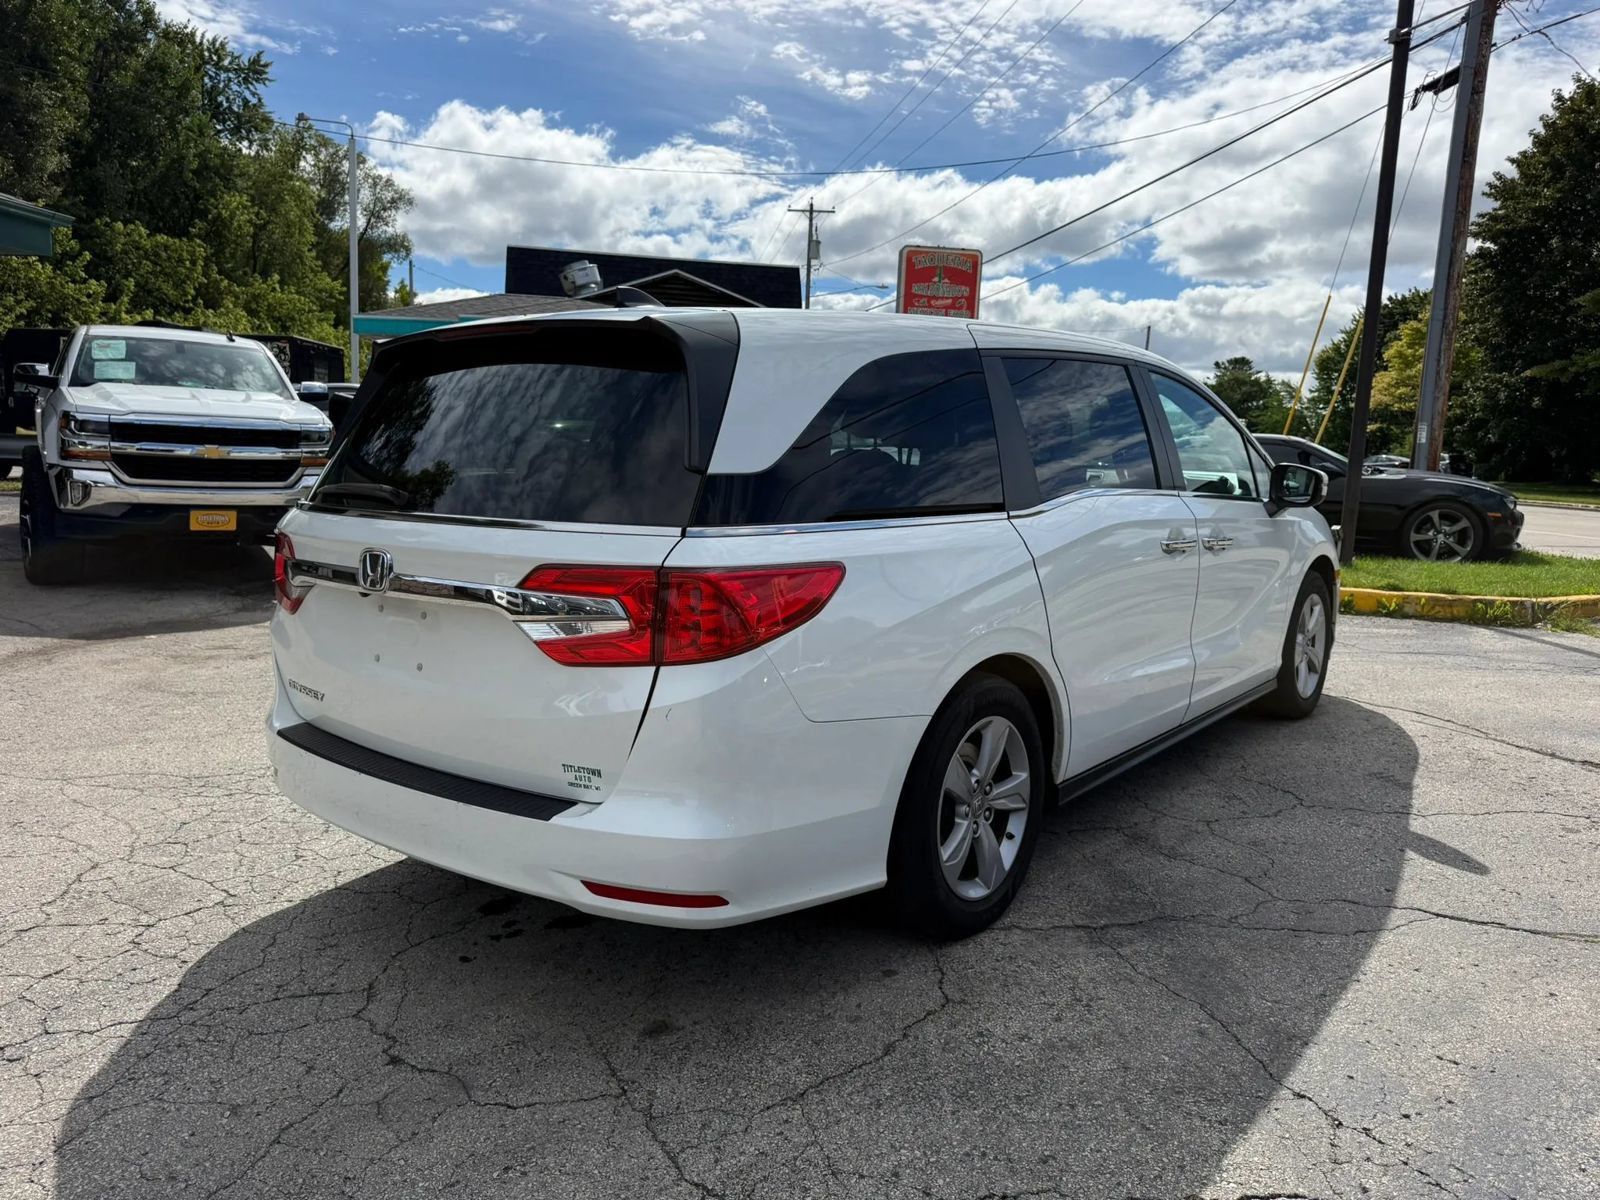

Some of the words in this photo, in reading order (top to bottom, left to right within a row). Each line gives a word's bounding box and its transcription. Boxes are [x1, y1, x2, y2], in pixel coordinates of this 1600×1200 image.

[912, 252, 973, 273] TAQUERIA
[288, 678, 325, 702] ODYSSEY
[561, 763, 602, 779] TITLETOWN
[574, 774, 592, 783] AUTO
